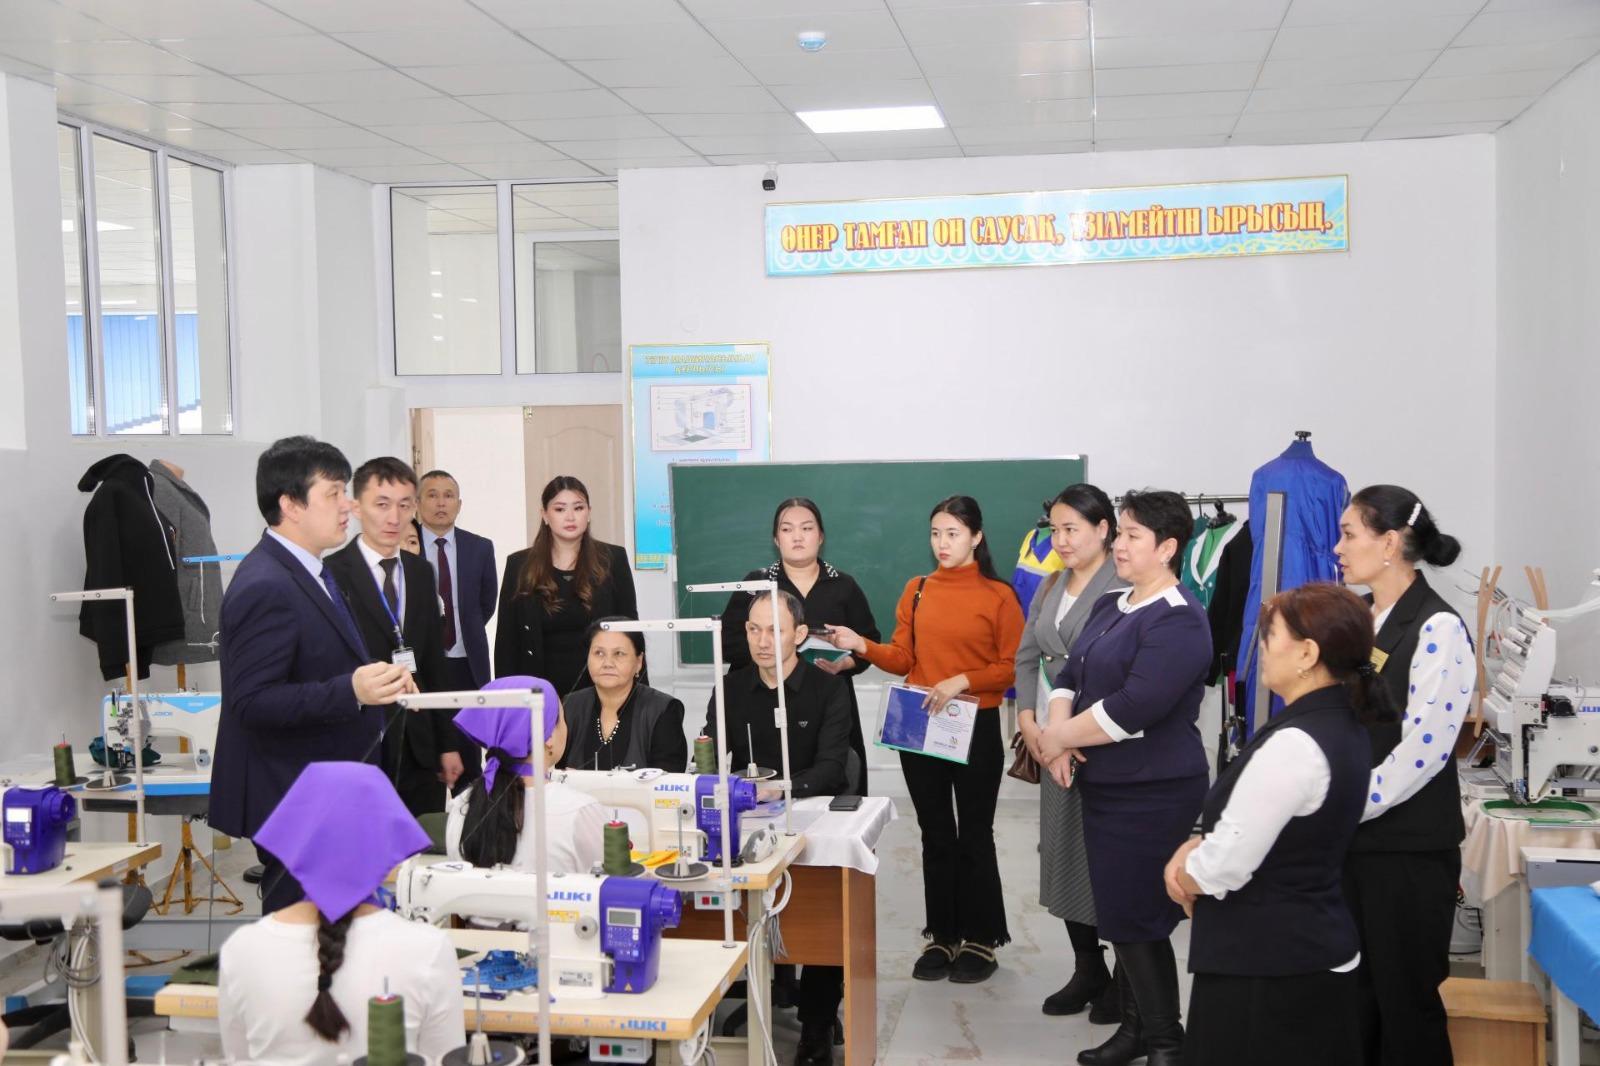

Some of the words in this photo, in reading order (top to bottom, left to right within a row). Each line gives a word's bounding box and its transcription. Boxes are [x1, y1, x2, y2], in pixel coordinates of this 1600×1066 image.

[780, 224, 839, 252] ӨНЕР
[843, 219, 928, 250] ТАМҒАН
[932, 217, 967, 246] ОН
[1207, 201, 1333, 235] ЫРЫСЫҢ.
[654, 784, 690, 792] JUKI
[547, 891, 593, 902] JUKI
[620, 1019, 668, 1032] JUKI
